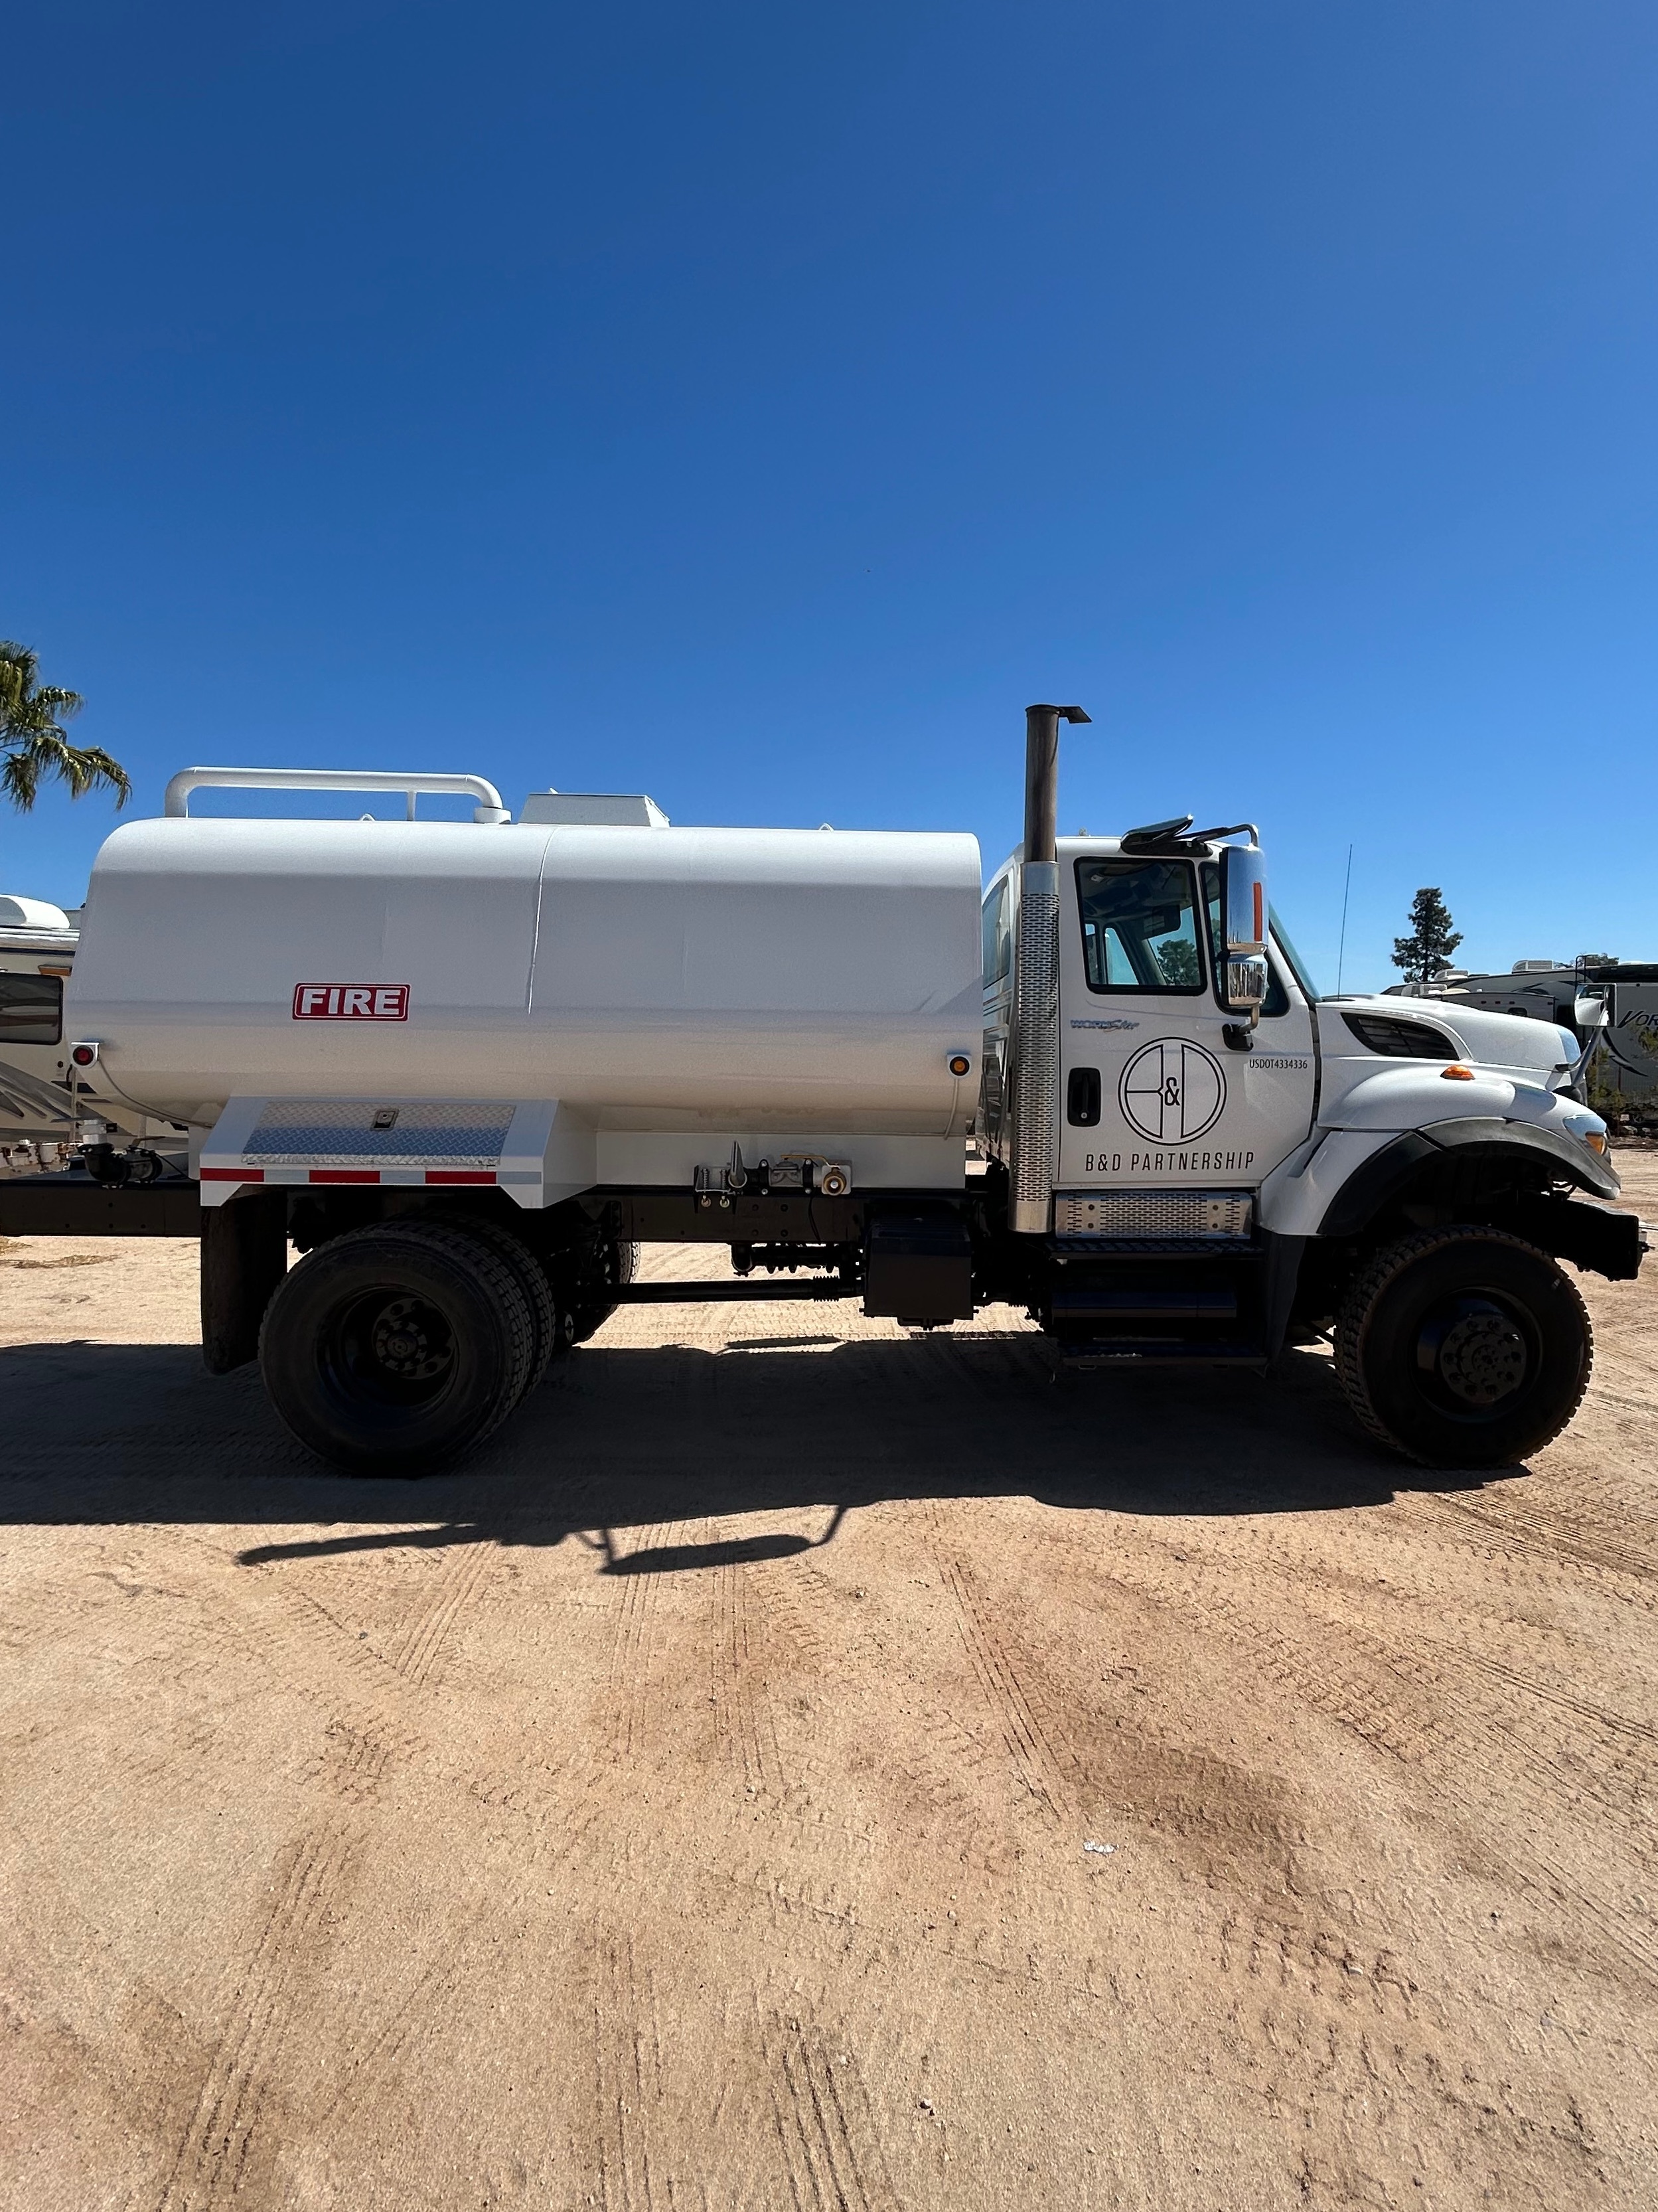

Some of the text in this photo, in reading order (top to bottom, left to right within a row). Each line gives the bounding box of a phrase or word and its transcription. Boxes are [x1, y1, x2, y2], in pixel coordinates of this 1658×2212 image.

[301, 988, 402, 1015] FIRE
[1249, 1058, 1308, 1069] USDOT4334336
[1085, 1152, 1254, 1172] B&D PARTNERSHIP
